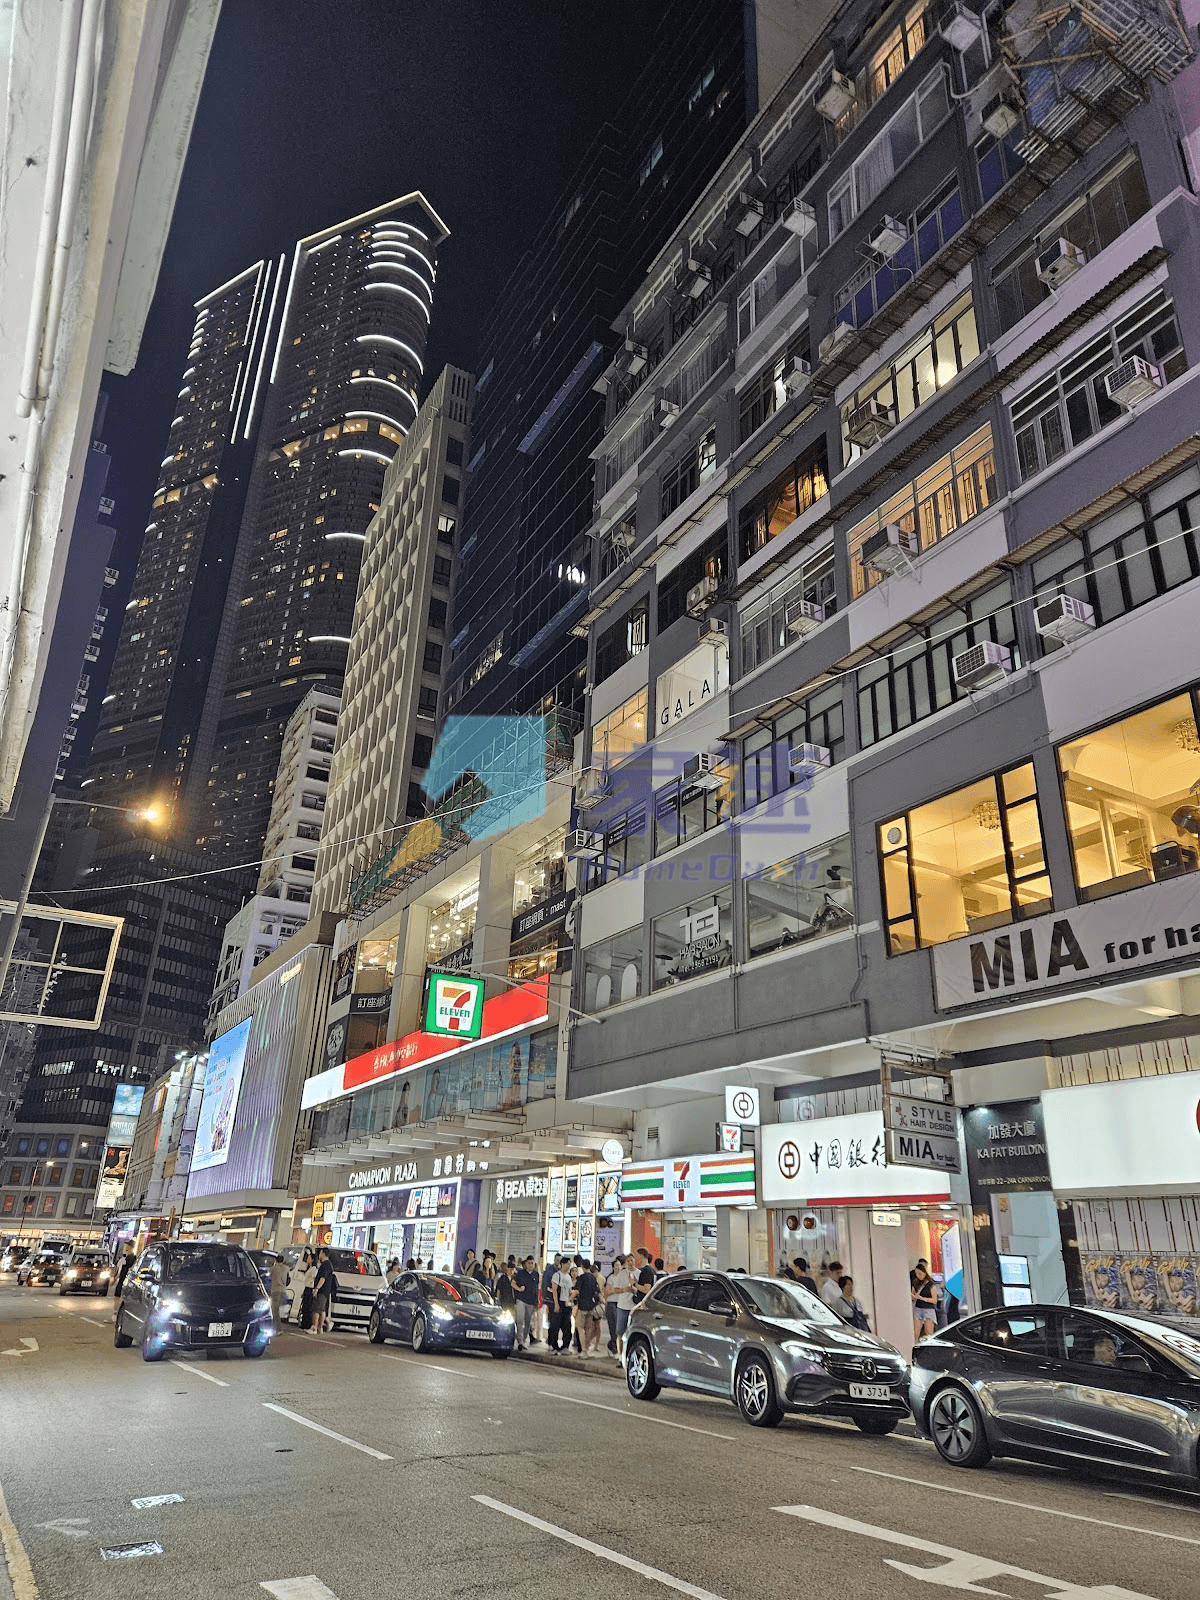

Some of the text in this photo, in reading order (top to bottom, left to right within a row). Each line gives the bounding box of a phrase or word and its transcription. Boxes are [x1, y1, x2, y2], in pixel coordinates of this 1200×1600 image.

[660, 679, 711, 725] GALA
[970, 919, 1089, 993] MIA
[1103, 935, 1156, 964] for
[911, 1106, 952, 1122] STYLE
[910, 1119, 954, 1133] HAIR DESIGN
[899, 1136, 935, 1160] MIA
[977, 1148, 990, 1159] KA
[990, 1146, 1008, 1158] FAT
[348, 1162, 418, 1189] CARNARVON PLAZA
[867, 1387, 888, 1399] 3734
